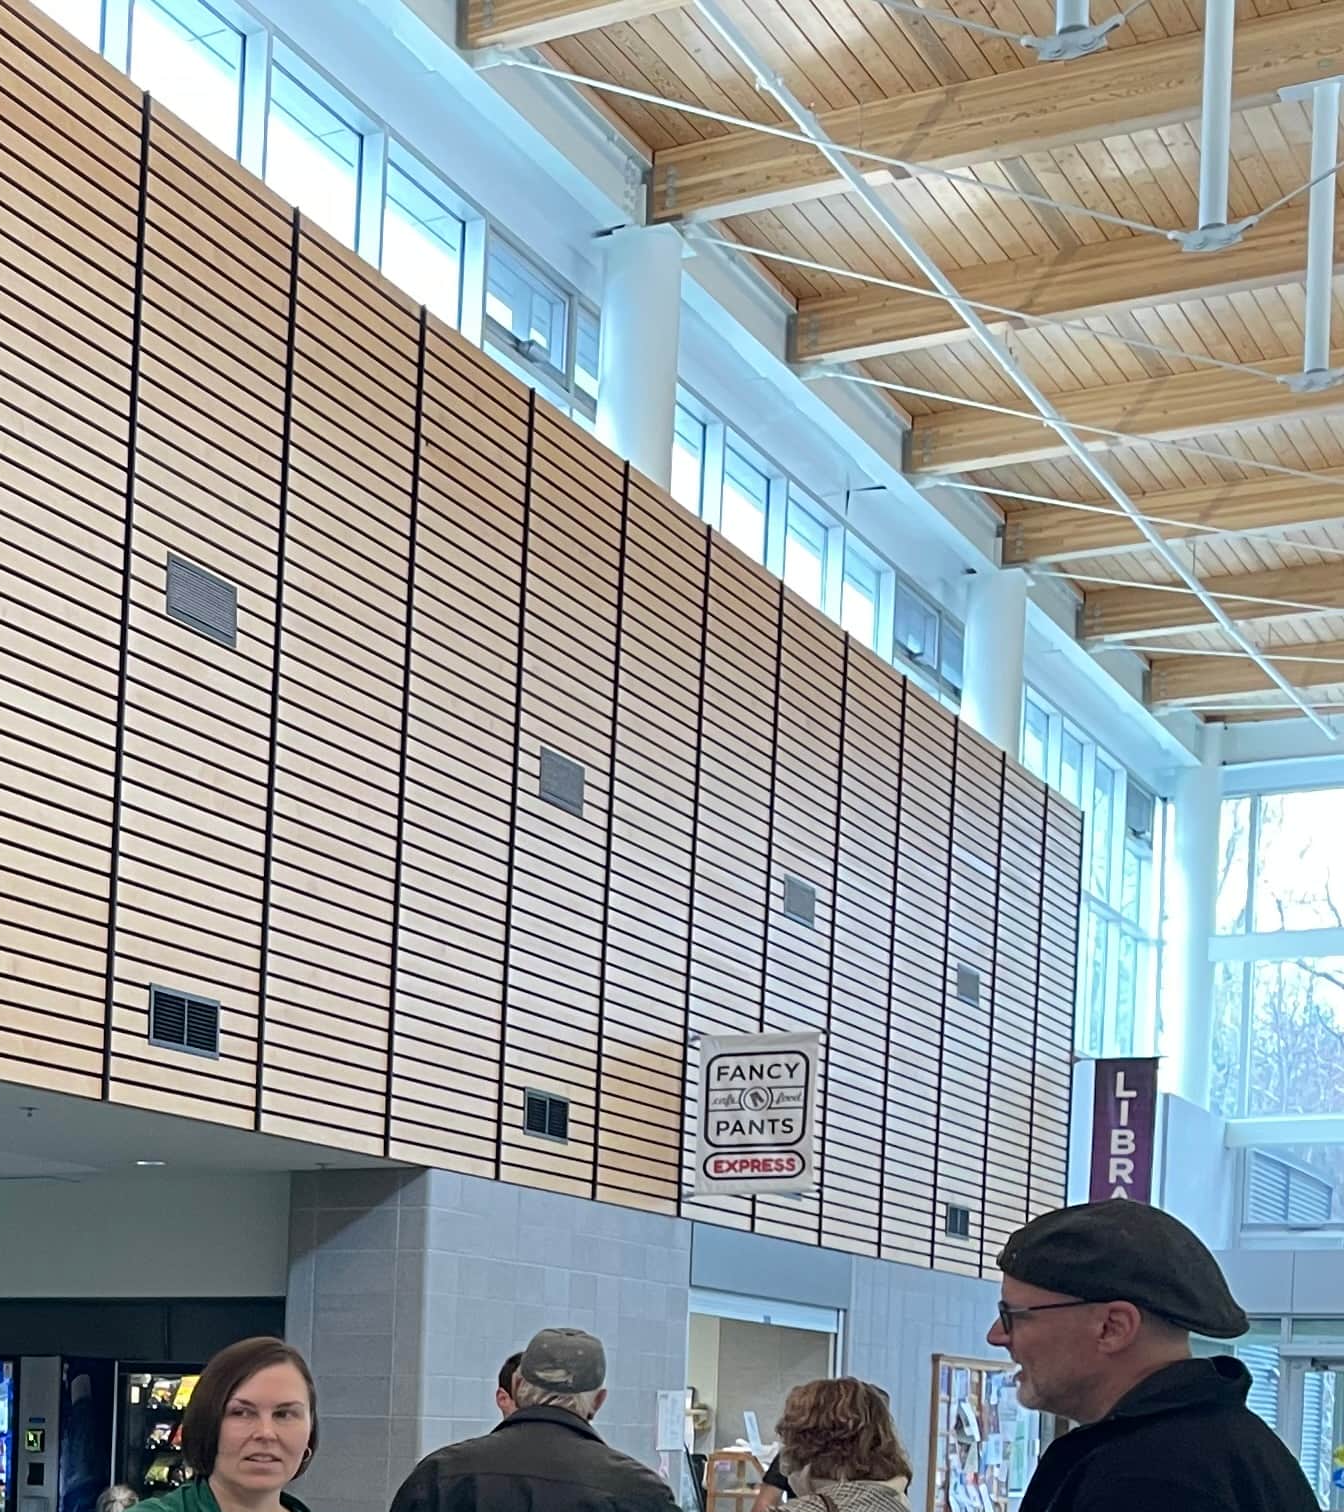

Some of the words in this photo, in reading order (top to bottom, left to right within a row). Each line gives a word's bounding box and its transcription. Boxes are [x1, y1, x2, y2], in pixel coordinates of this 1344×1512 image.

[716, 1062, 801, 1082] FANCY
[716, 1118, 794, 1136] PANTS
[713, 1157, 796, 1174] EXPRESS
